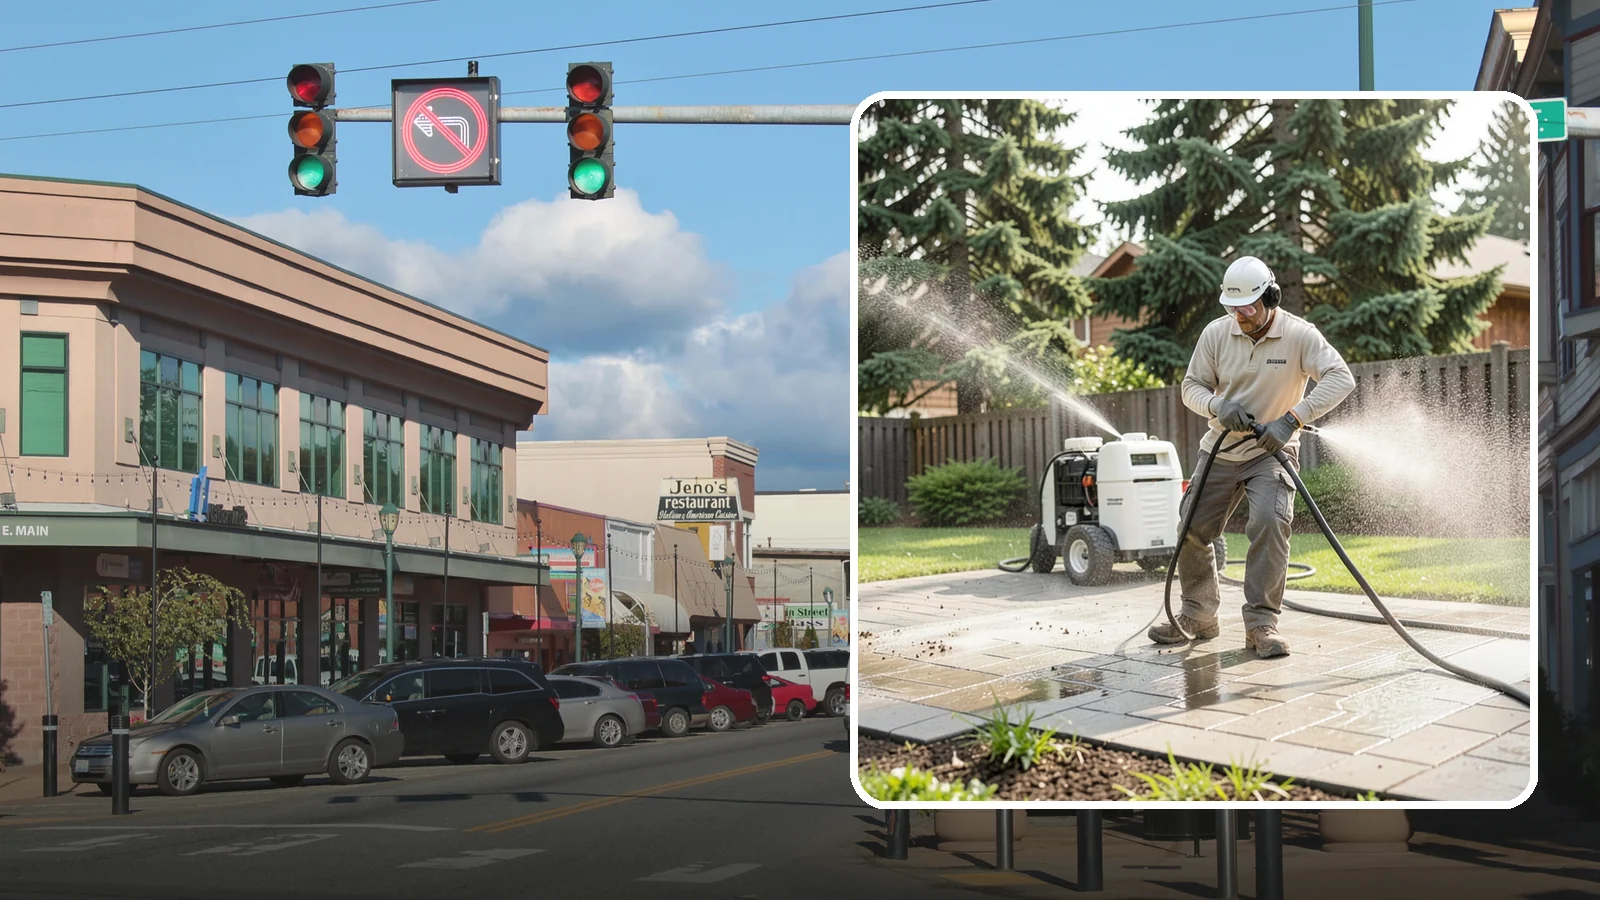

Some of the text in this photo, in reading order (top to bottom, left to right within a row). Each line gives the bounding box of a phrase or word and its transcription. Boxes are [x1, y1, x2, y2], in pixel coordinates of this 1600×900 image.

[670, 480, 728, 494] Jeno's
[665, 497, 731, 509] restaurant
[659, 510, 681, 520] Italian
[686, 510, 714, 519] American
[715, 509, 738, 519] Cuisine
[2, 525, 49, 536] E. MAIN
[797, 607, 828, 617] Street
